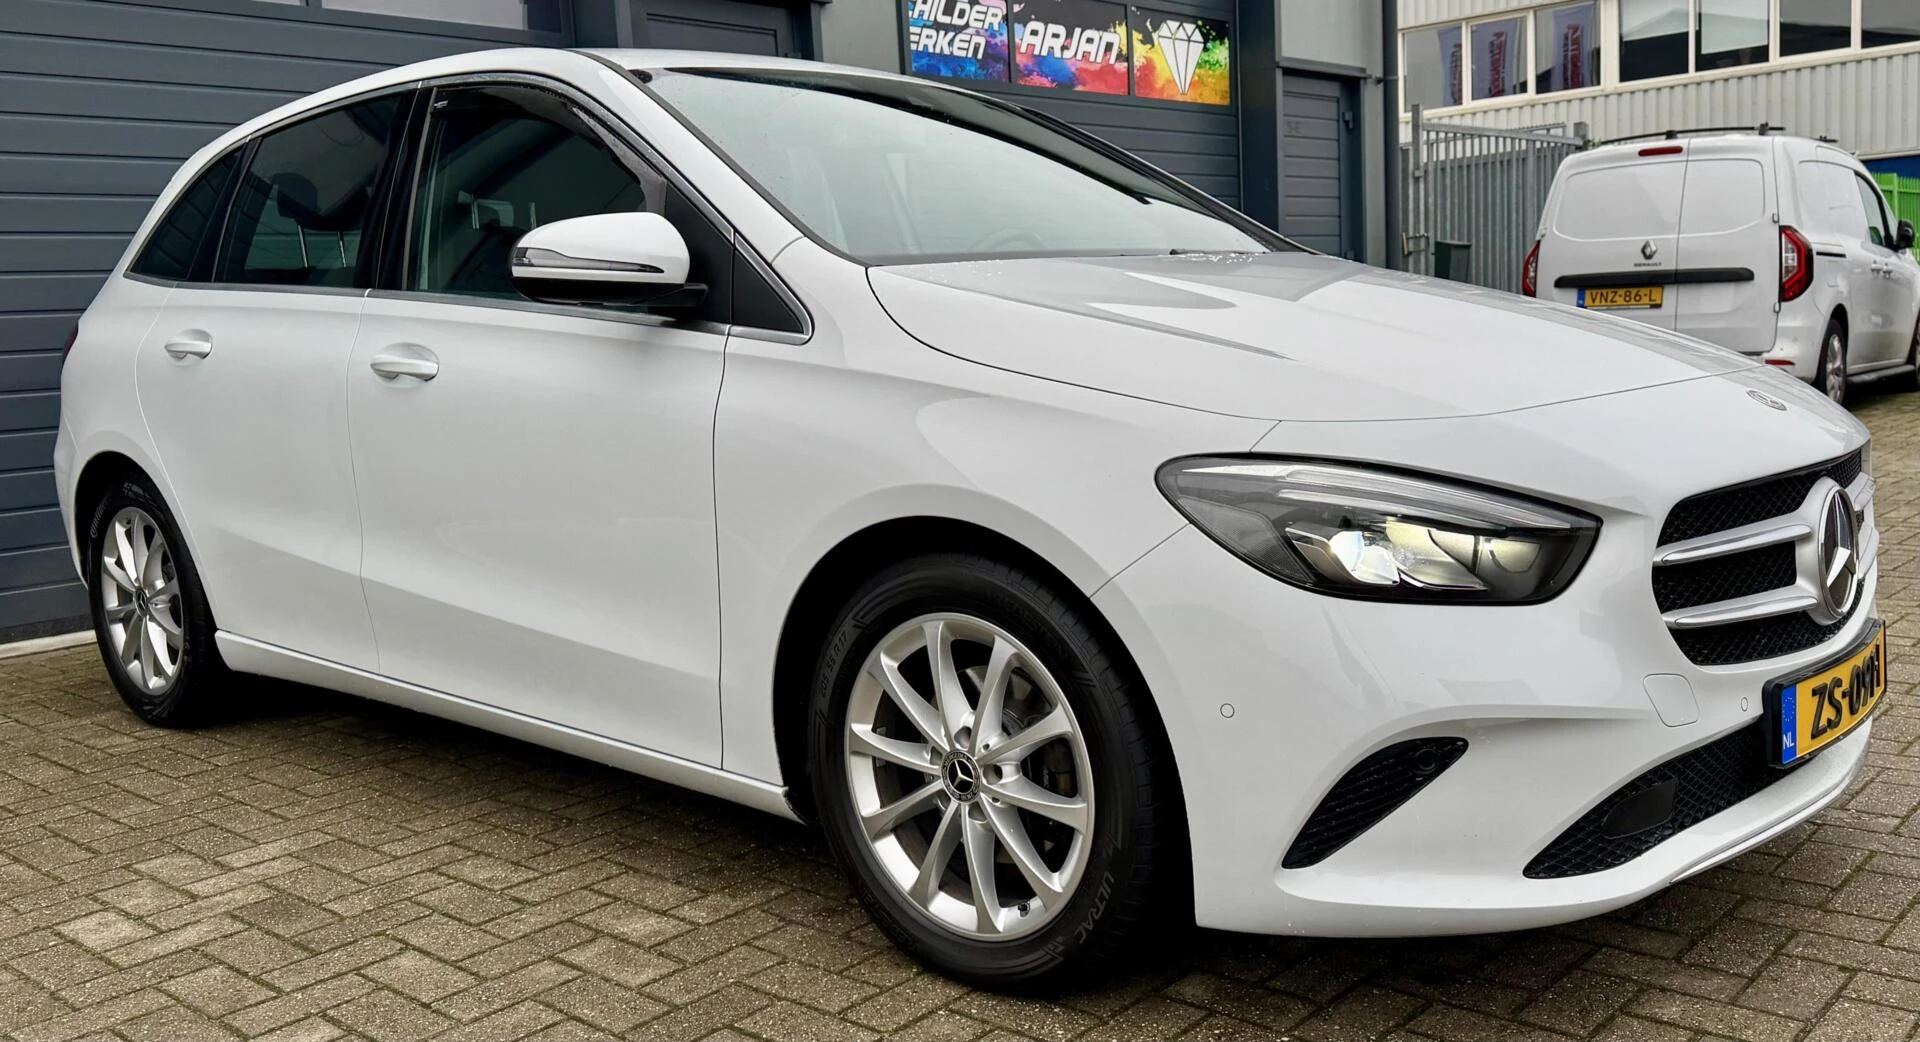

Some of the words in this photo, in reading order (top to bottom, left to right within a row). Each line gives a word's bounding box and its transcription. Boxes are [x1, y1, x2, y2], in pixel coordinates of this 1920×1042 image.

[909, 0, 1003, 31] HILDER
[1020, 20, 1120, 65] ARJAN
[1590, 289, 1657, 304] VNZ-86-L
[1782, 732, 1795, 750] NL
[1073, 871, 1115, 945] ULTRAC
